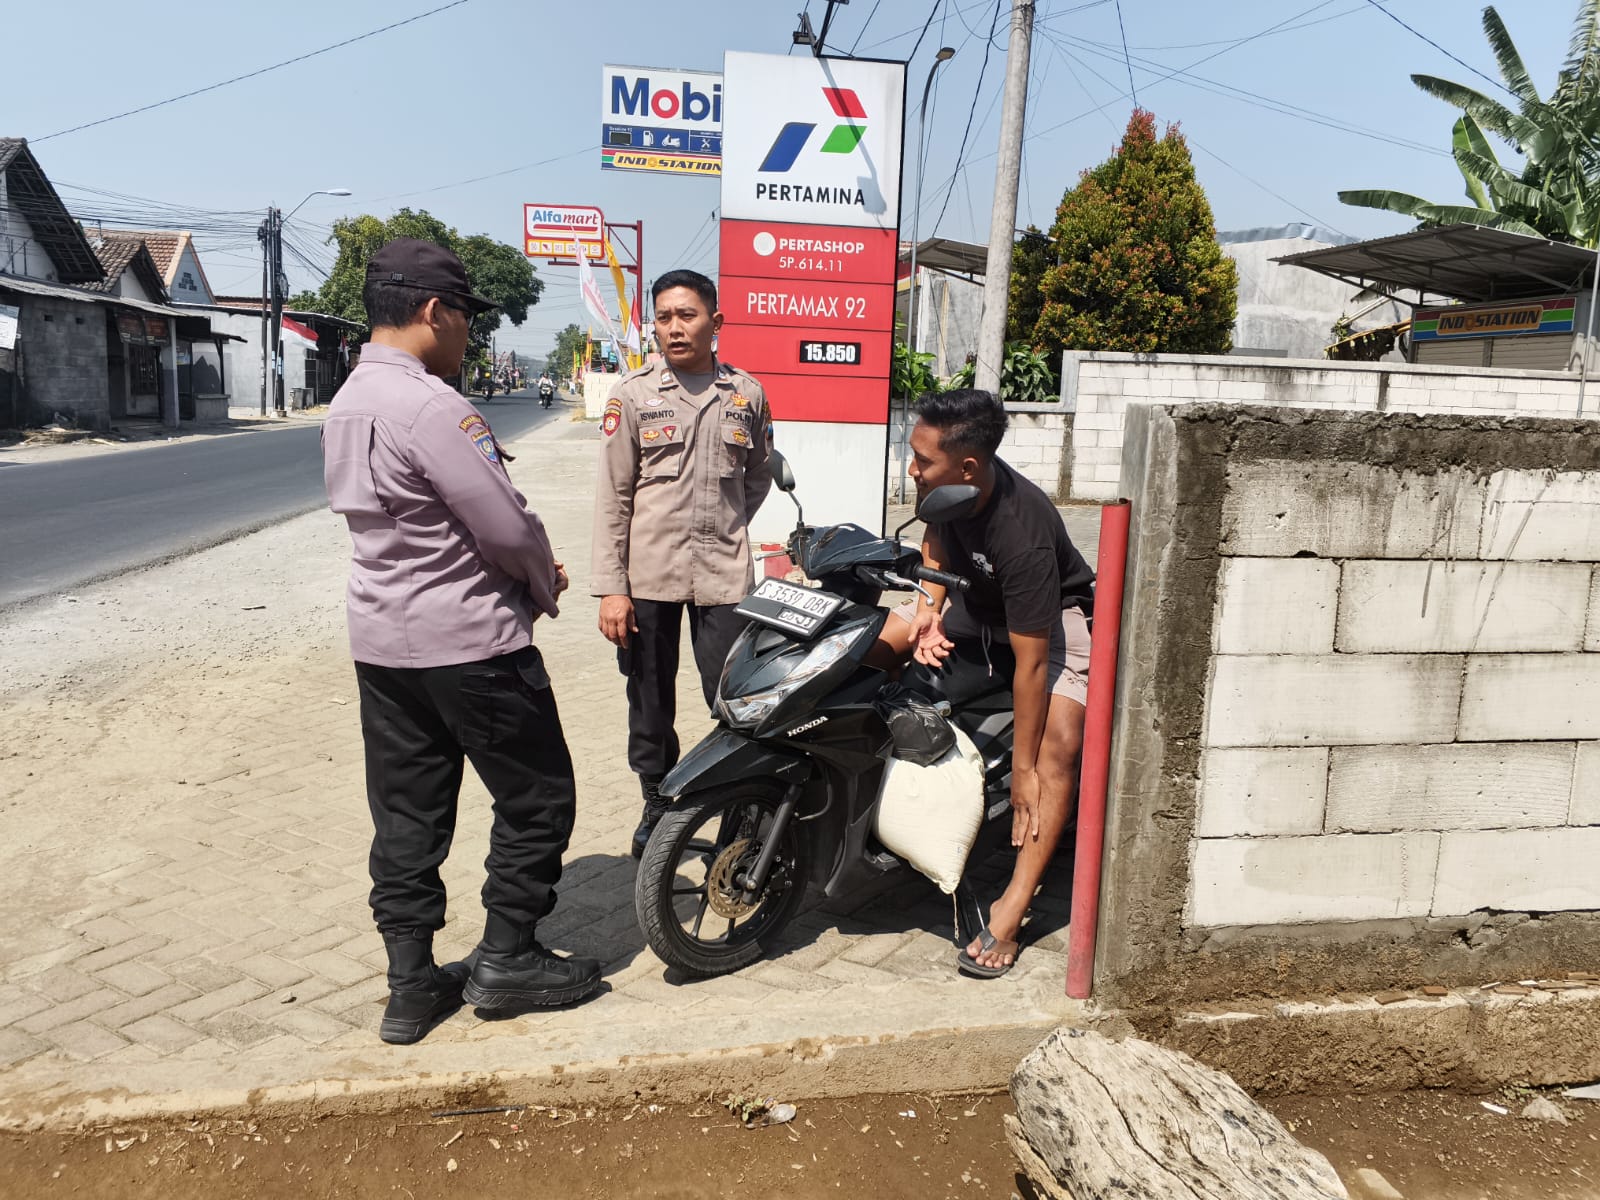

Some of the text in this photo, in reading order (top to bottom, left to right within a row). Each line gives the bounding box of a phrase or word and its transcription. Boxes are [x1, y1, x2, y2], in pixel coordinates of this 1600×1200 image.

[611, 75, 721, 122] Mobi
[756, 183, 865, 206] PERTAMINA
[533, 210, 598, 225] Alfamart
[779, 238, 864, 254] PERTASHOP
[747, 292, 866, 319] PERTAMAX 92
[805, 344, 856, 362] 15.850
[640, 410, 674, 421] ISWANTO
[758, 583, 773, 596] S
[769, 586, 805, 606] 3539
[787, 715, 829, 737] HONDA
